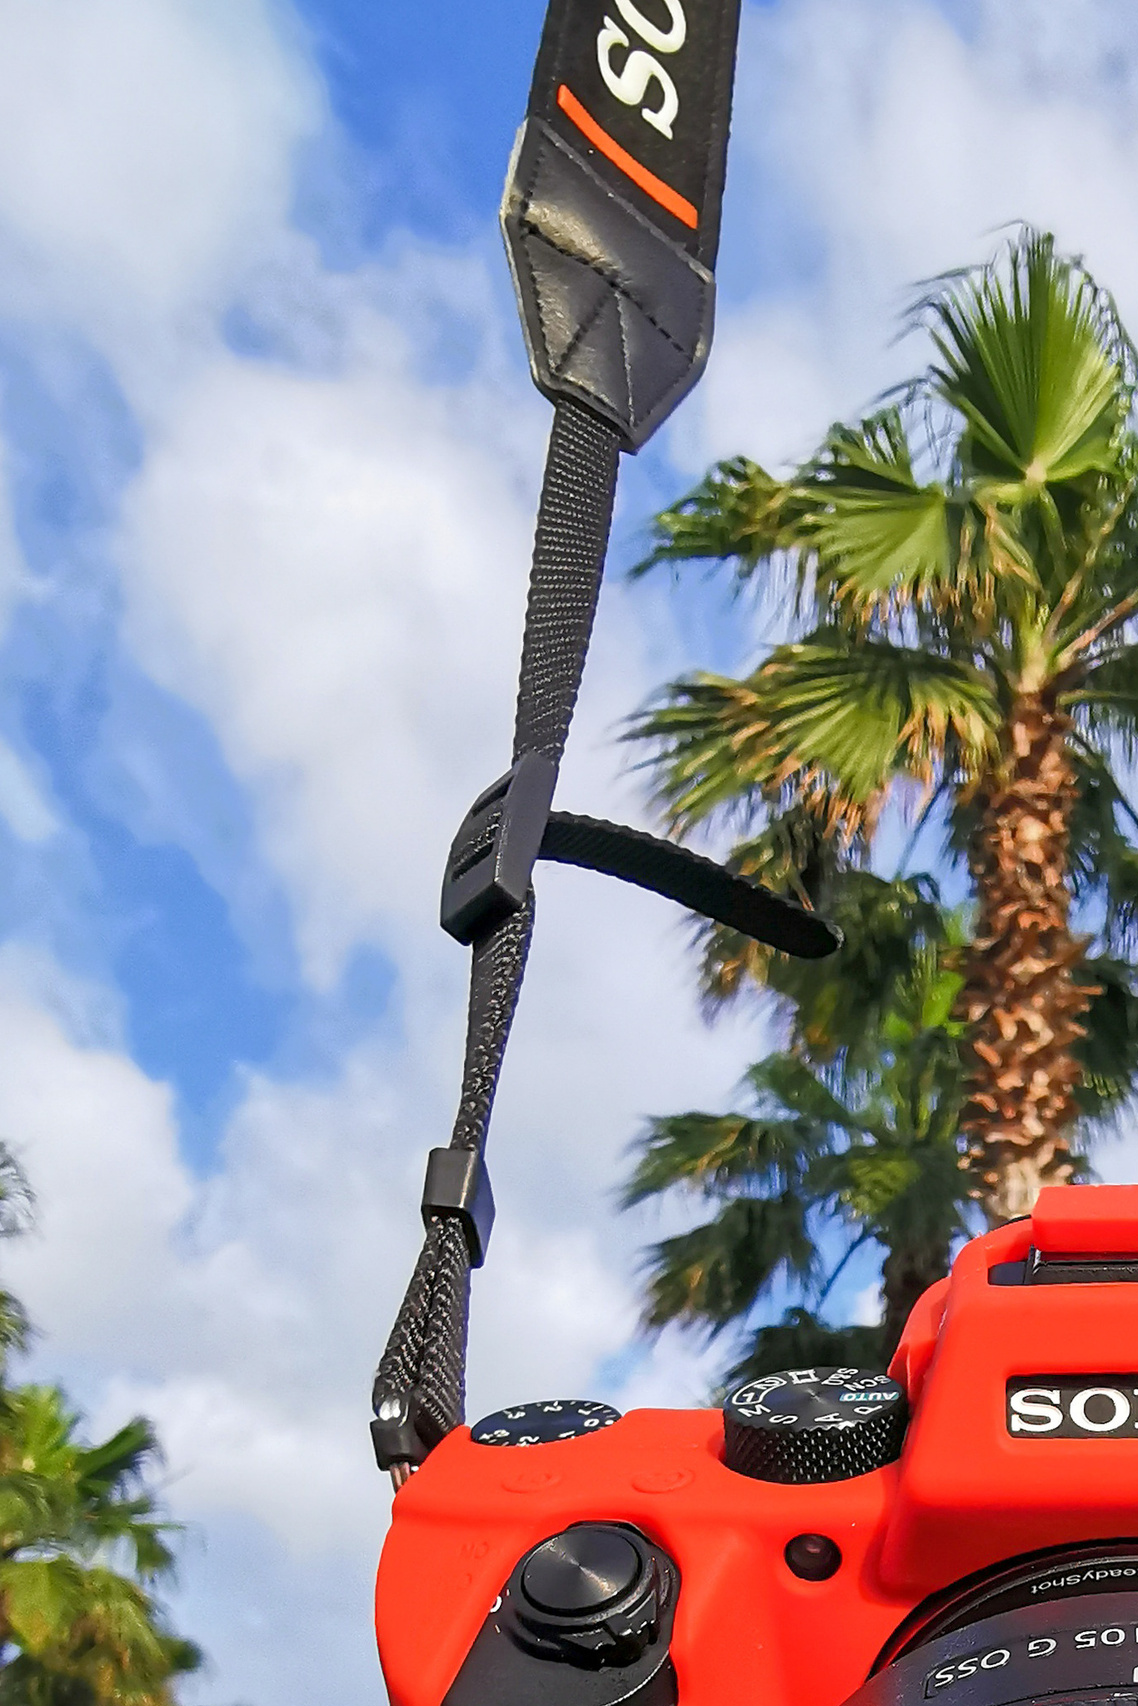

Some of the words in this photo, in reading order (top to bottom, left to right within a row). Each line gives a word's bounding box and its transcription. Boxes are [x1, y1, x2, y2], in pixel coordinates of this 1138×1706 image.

[843, 1392, 898, 1401] AUTO
[738, 1404, 771, 1417] M
[853, 1405, 883, 1415] P
[769, 1414, 798, 1424] S
[814, 1413, 843, 1422] A
[1028, 1638, 1057, 1658] G
[935, 1649, 1011, 1688] OSS
